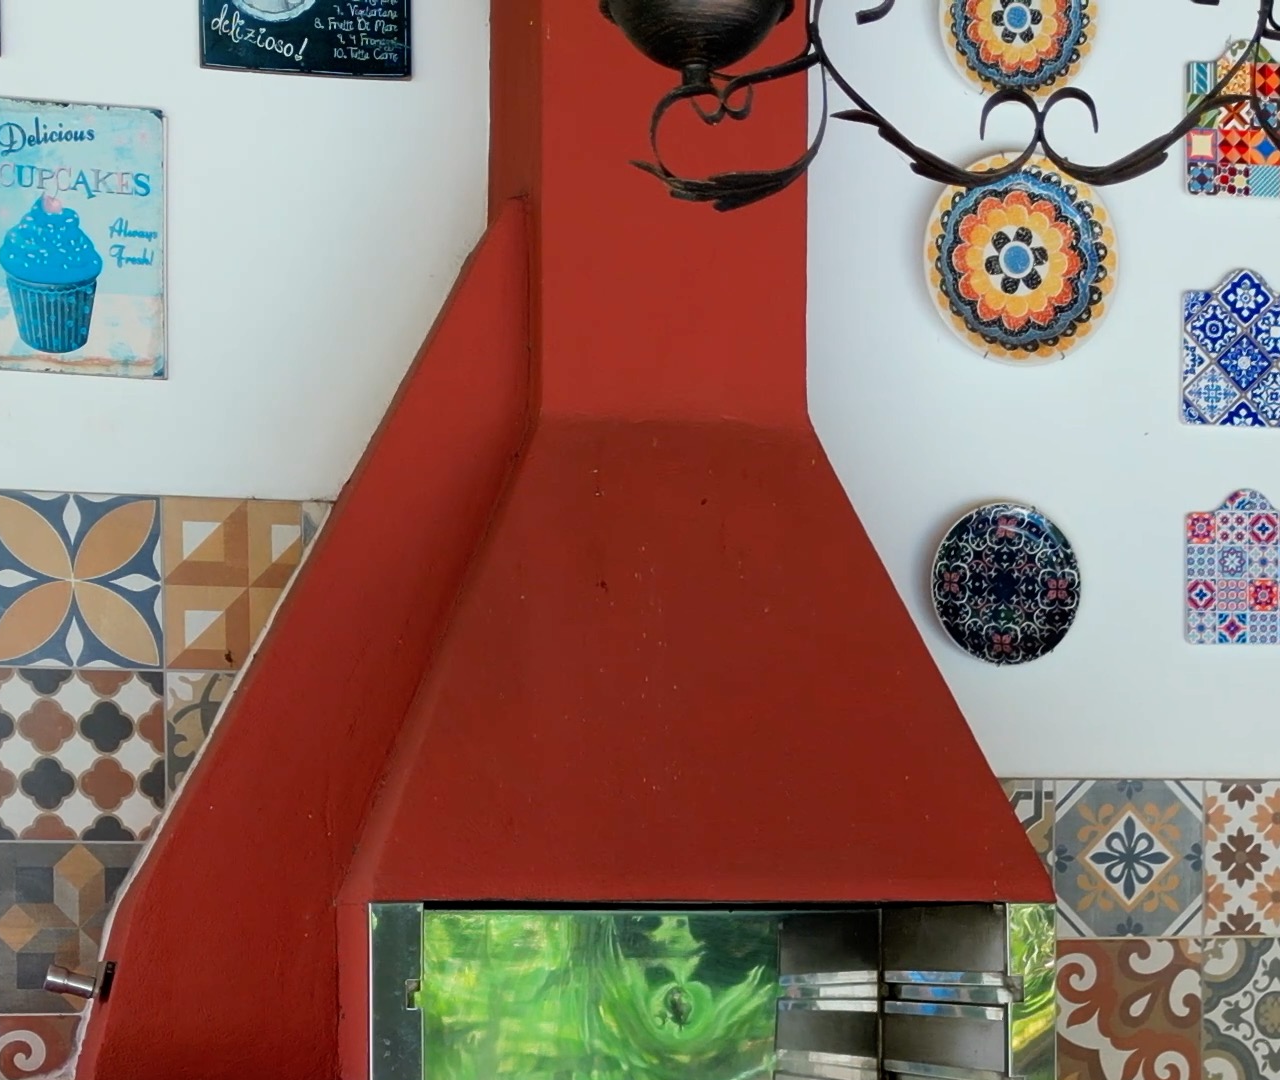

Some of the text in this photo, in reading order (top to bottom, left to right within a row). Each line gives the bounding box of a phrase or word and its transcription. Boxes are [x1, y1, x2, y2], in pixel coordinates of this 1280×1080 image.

[210, 3, 308, 62] delizioso!
[109, 217, 157, 242] Always
[109, 244, 154, 268] Fresh!
